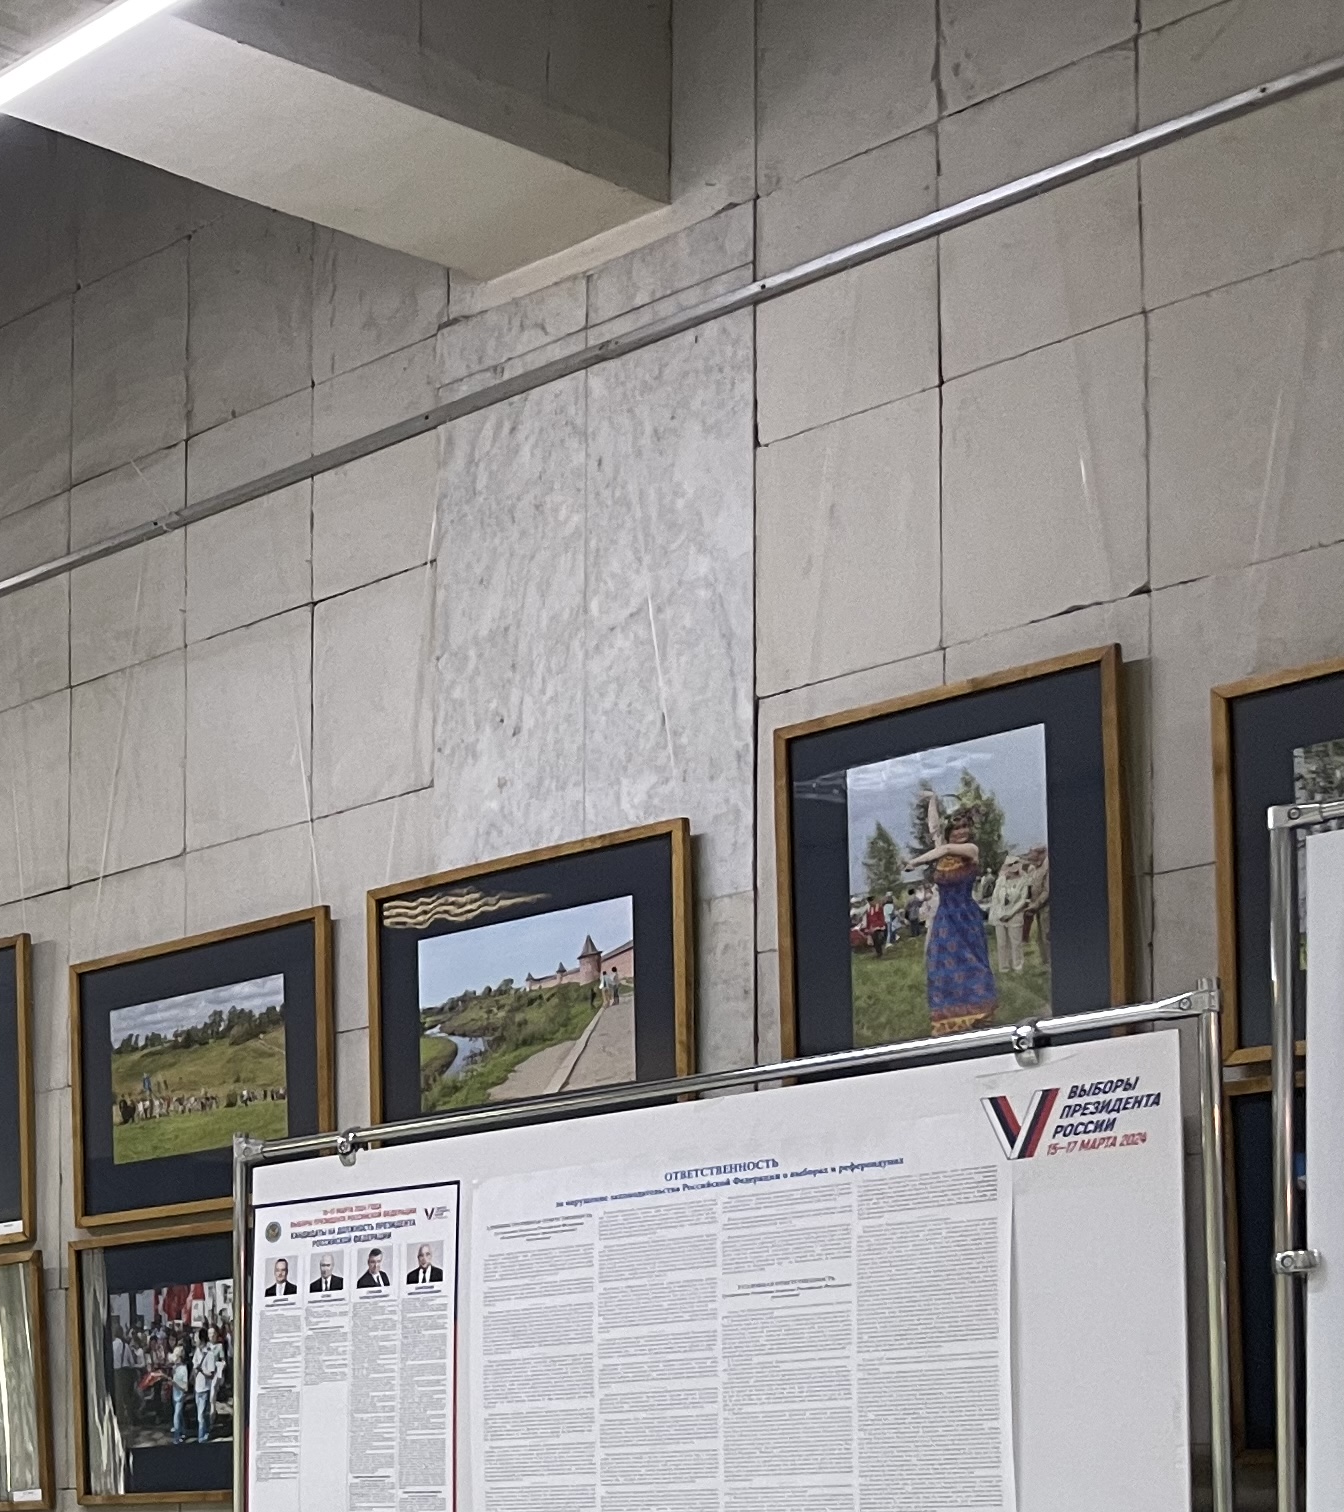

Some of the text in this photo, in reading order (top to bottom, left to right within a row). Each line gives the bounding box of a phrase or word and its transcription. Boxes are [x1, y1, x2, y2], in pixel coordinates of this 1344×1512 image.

[1067, 1076, 1140, 1099] ВЫБОРЫ
[1059, 1092, 1162, 1119] ПРЕЗИДЕНТА
[1052, 1117, 1117, 1139] РОССИИ
[1078, 1135, 1118, 1151] МАРТА
[1119, 1132, 1148, 1147] 2024
[664, 1158, 779, 1182] ОТВЕТСТВЕННОСТЬ
